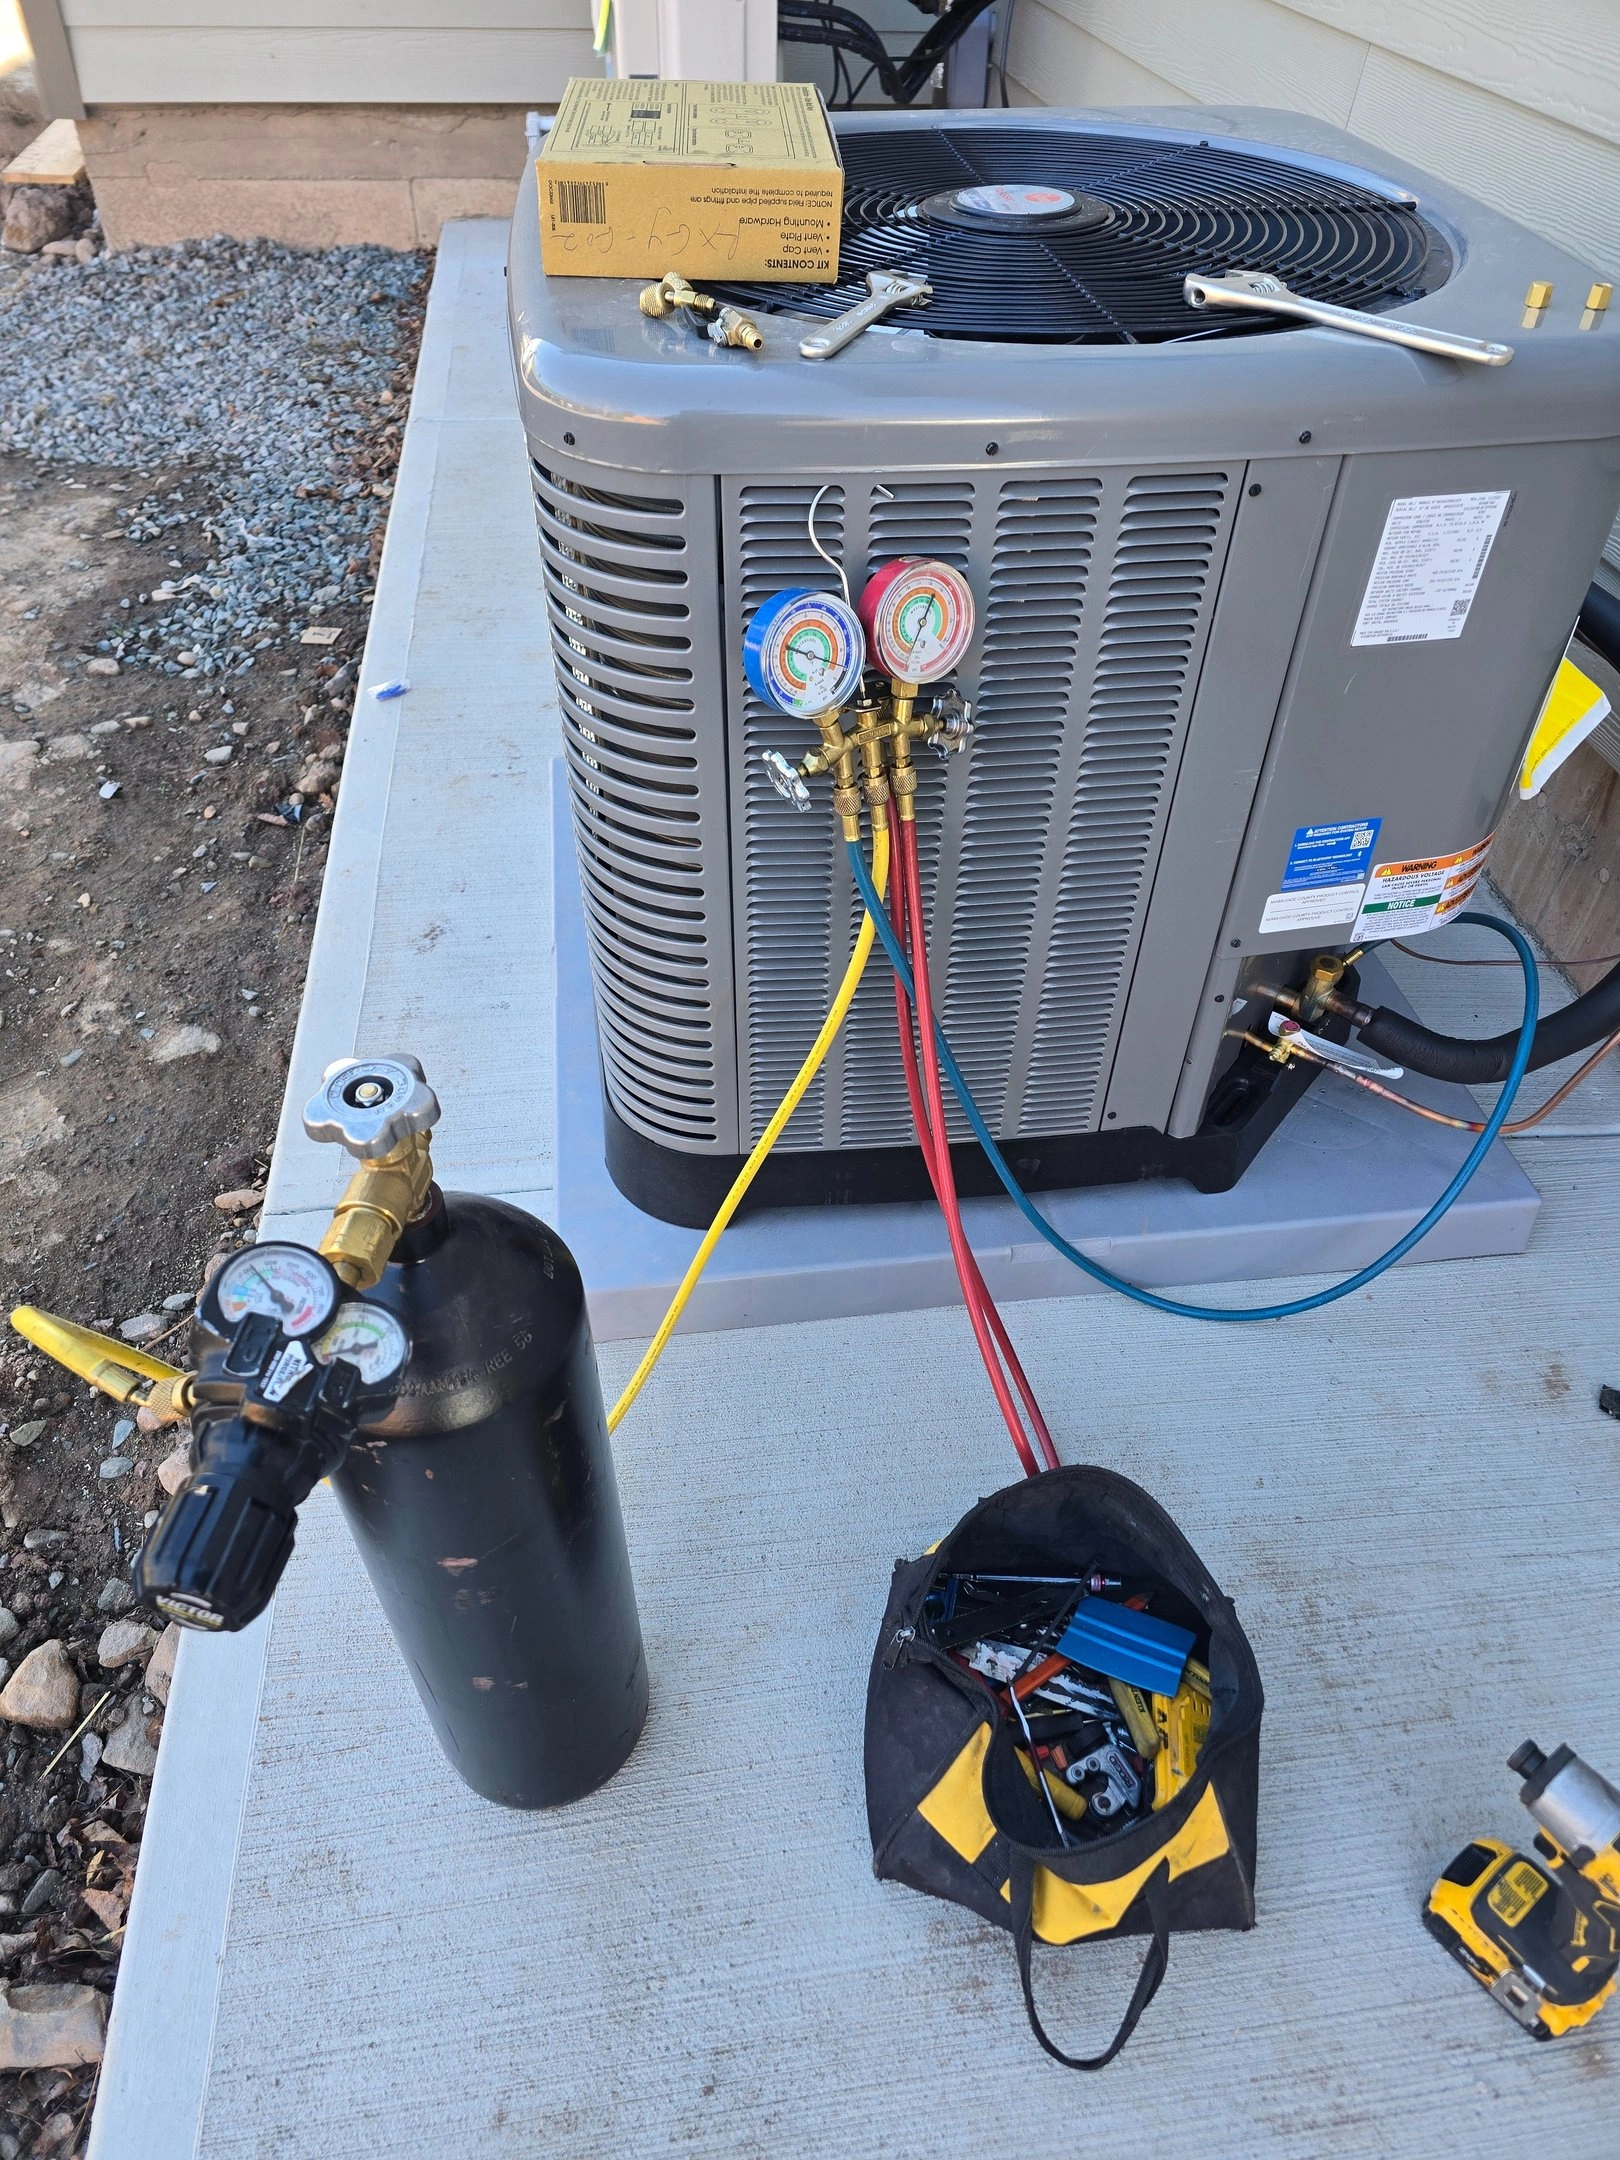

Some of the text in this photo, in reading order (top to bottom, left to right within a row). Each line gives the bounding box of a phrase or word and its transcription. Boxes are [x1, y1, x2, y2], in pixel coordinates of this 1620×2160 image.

[704, 196, 725, 204] fittings
[742, 197, 757, 205] pipe
[759, 197, 787, 206] supplied
[739, 217, 823, 228] Mounting Hardware
[781, 232, 823, 241] Vent Plate
[783, 244, 822, 255] Vent Cap
[764, 259, 829, 269] KIT CONTENTS:
[1337, 821, 1368, 830] CONTRACTORS
[1401, 860, 1438, 874] WARNING
[1382, 869, 1445, 883] HAZARDOUS VOLTAGE
[1387, 899, 1415, 910] NOTICE
[155, 1595, 224, 1625] VICTOR
[1132, 1692, 1145, 1713] KLEIN
[1109, 1755, 1133, 1788] RIDGID
